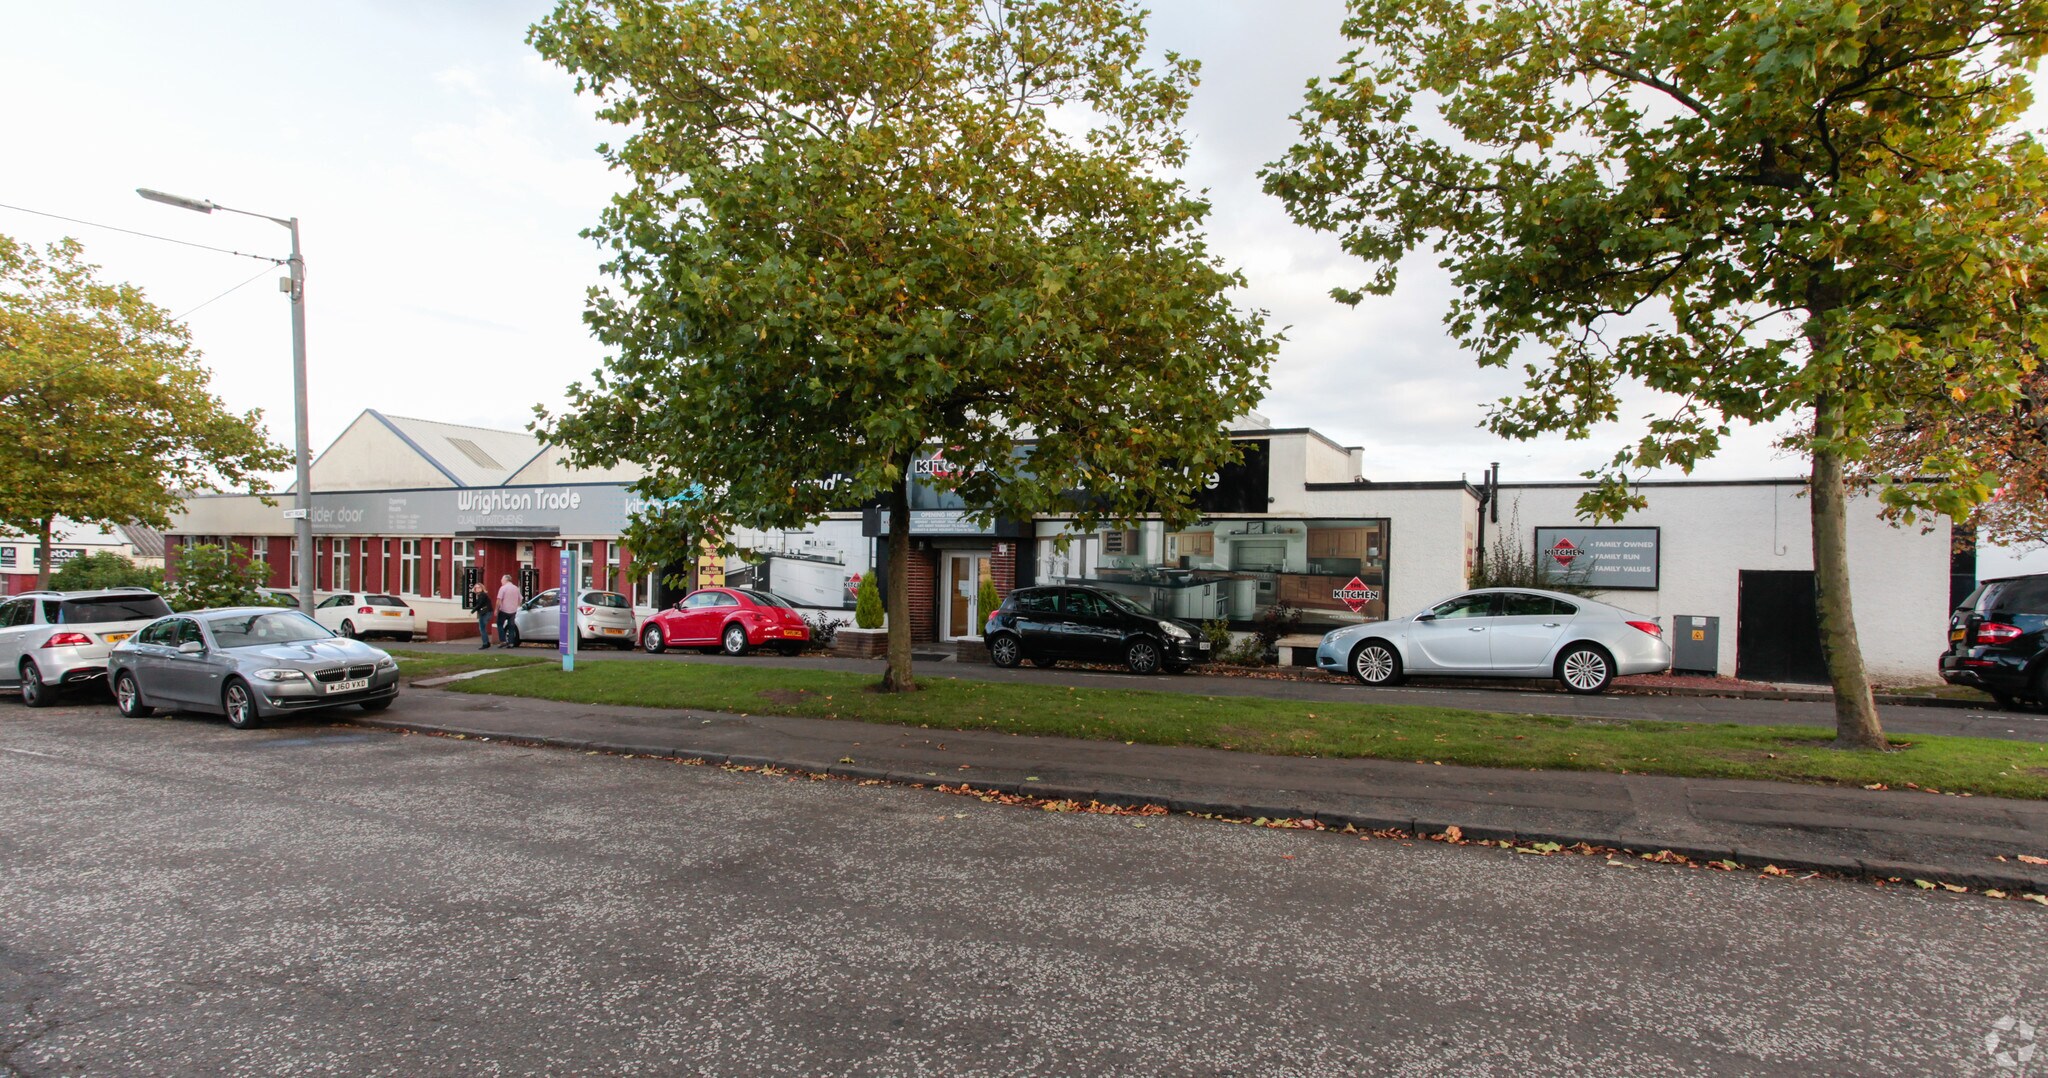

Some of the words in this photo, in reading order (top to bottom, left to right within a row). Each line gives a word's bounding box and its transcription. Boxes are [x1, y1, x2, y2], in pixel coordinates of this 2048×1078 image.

[457, 489, 532, 515] Wrighton
[534, 487, 581, 510] Trade
[310, 506, 335, 522] lider
[337, 506, 364, 522] door
[457, 514, 487, 525] QUALITY
[487, 514, 523, 525] KITCHENS
[51, 549, 79, 558] etCut
[1544, 548, 1585, 556] KITCHEN
[1622, 565, 1651, 573] VALUES
[1333, 590, 1379, 600] KITCHEN
[330, 682, 350, 691] WJ60
[352, 680, 366, 688] VXD
